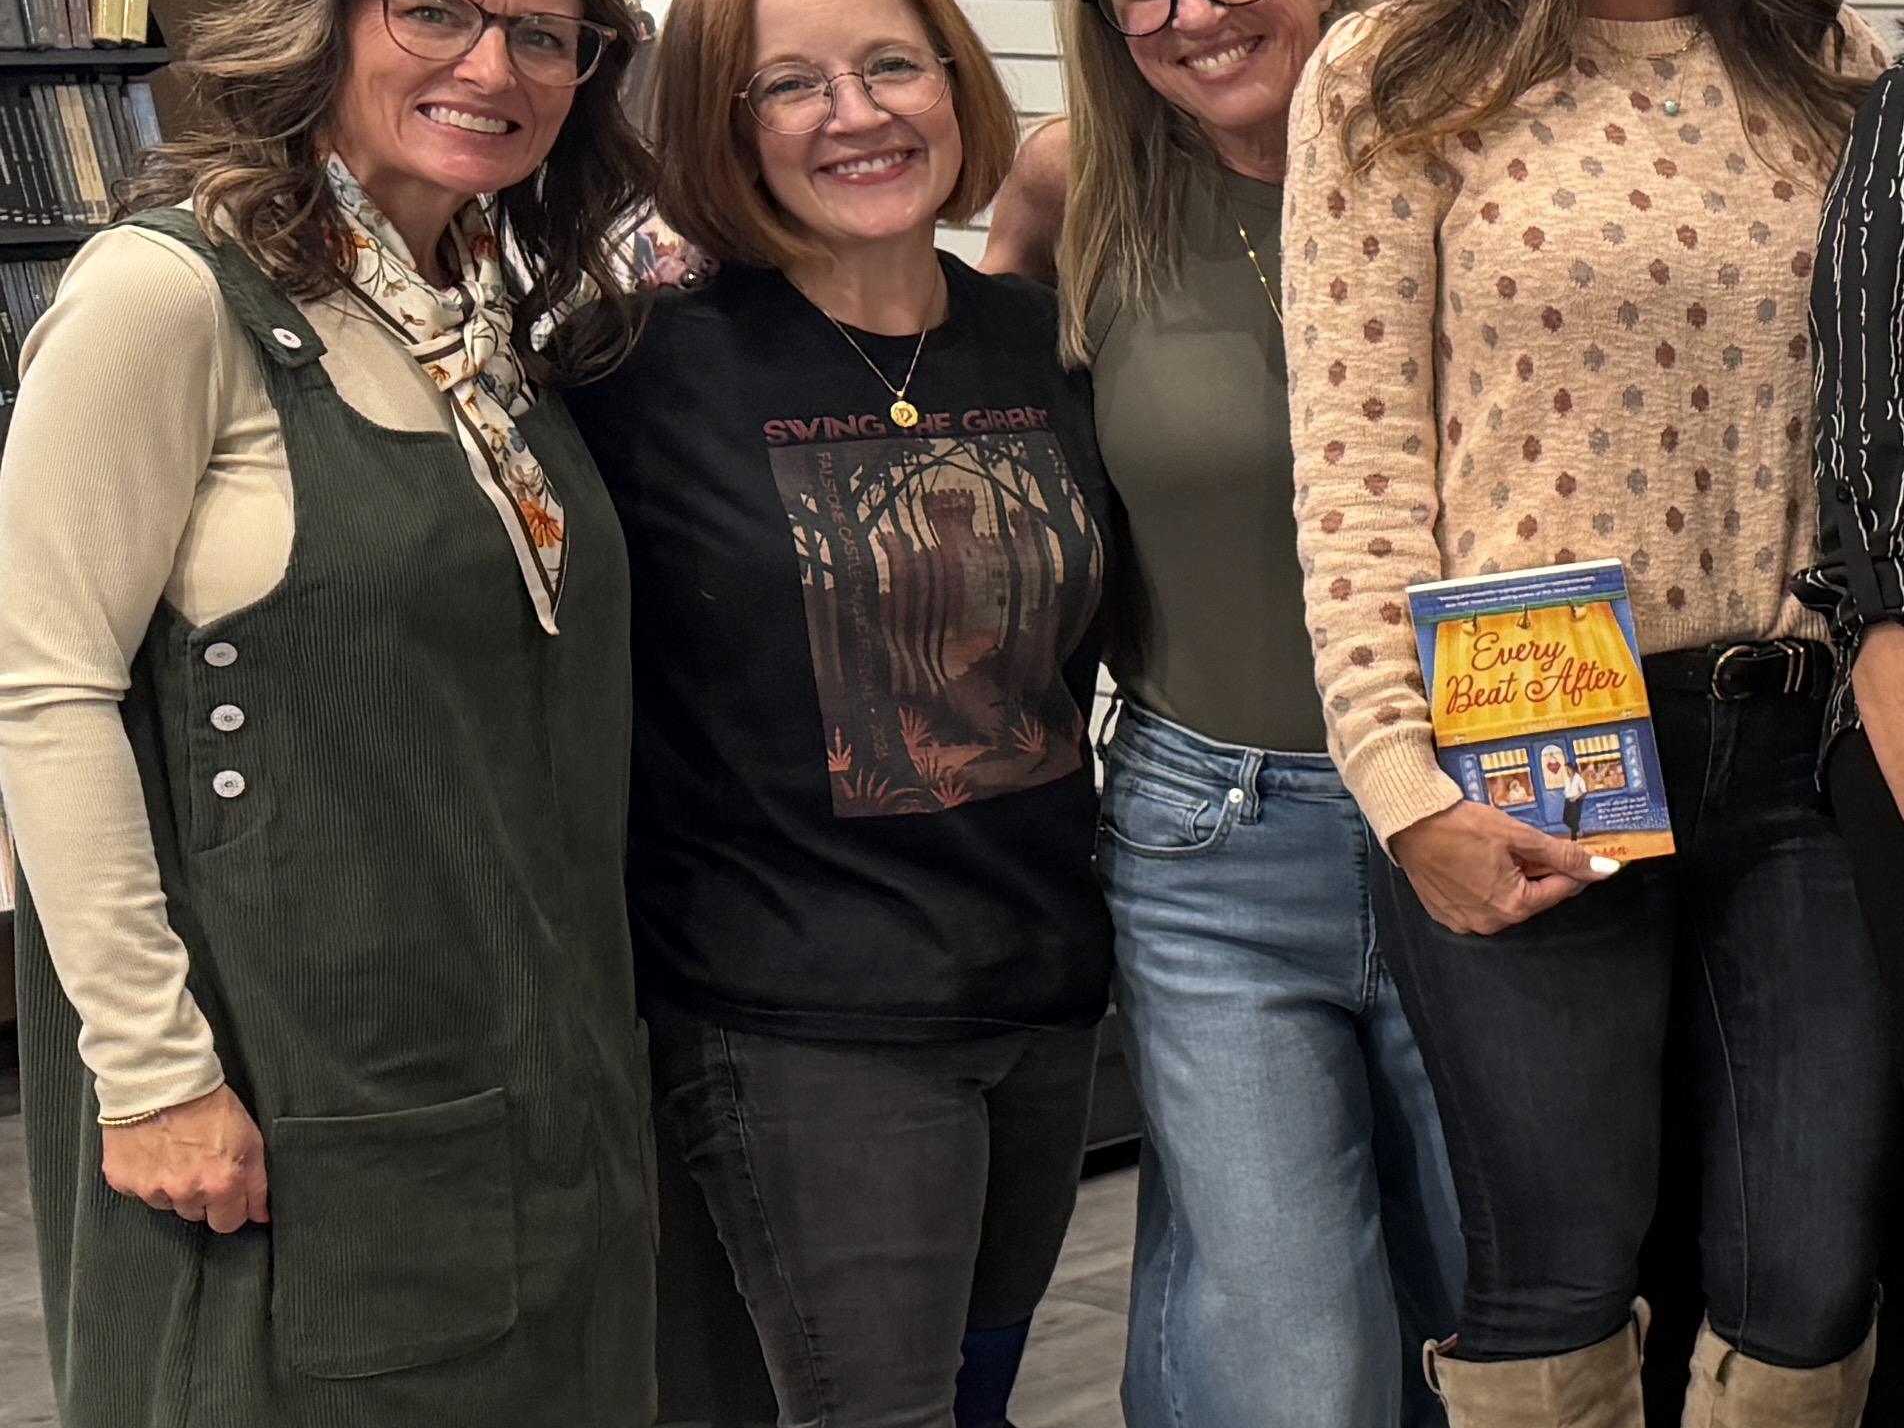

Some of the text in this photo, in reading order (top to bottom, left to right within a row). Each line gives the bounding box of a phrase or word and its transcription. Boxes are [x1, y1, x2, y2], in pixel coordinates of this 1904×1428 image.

[763, 414, 887, 446] SWING
[1471, 631, 1567, 673] Every
[1445, 657, 1628, 715] Beat After
